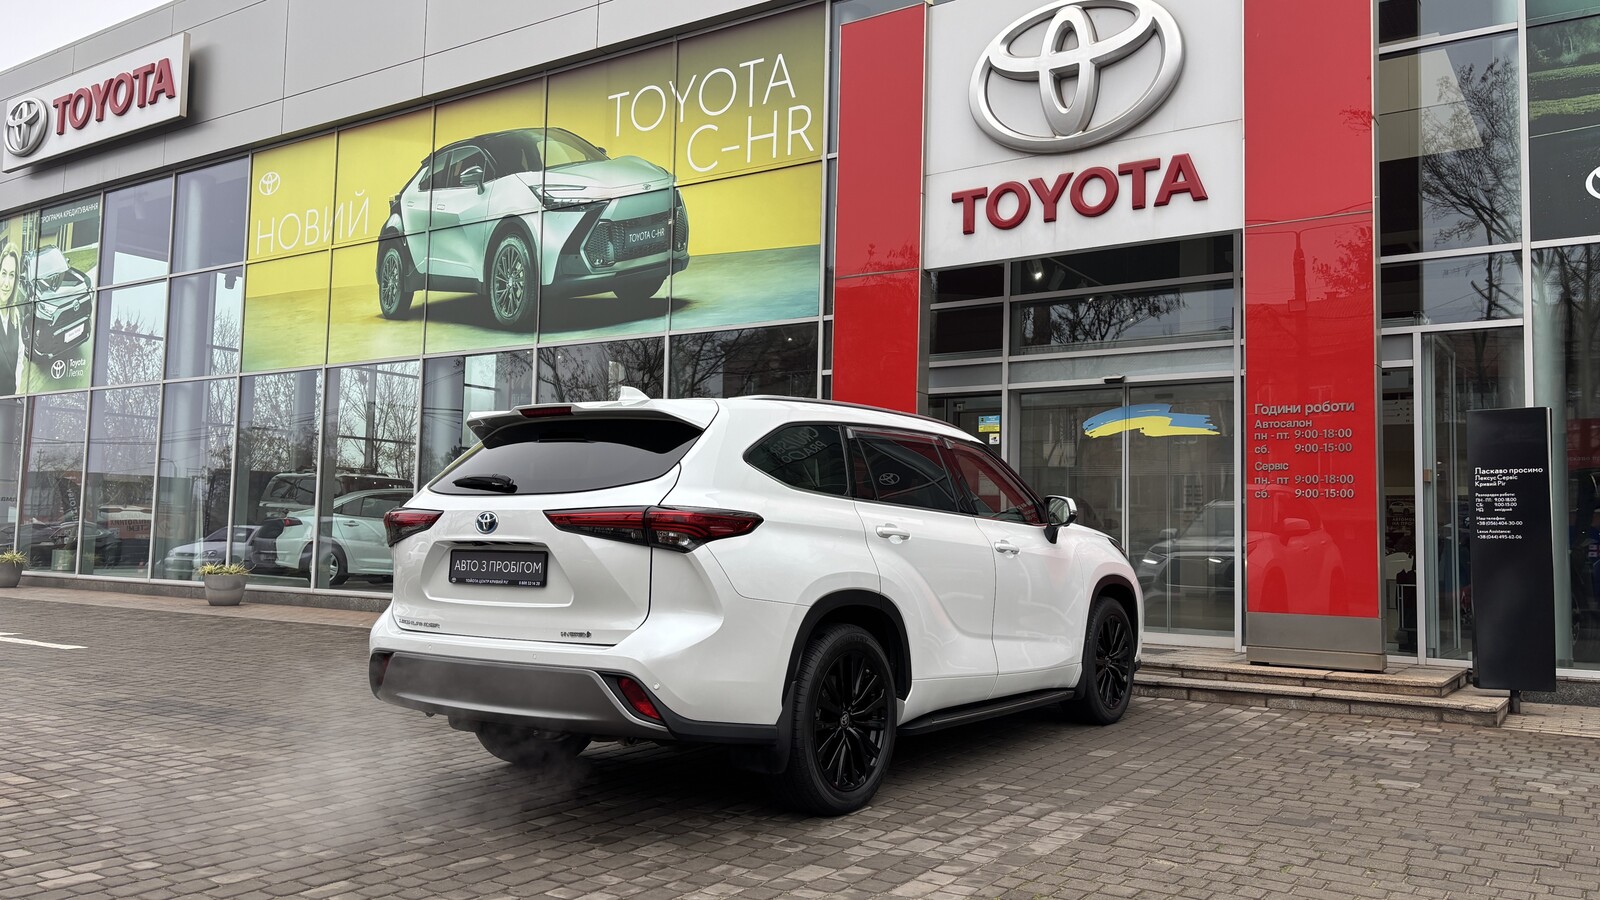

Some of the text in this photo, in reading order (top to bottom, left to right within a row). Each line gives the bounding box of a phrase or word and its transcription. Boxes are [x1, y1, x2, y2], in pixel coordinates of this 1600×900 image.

[53, 57, 176, 135] TOYOTA
[607, 52, 796, 137] TOYOTA
[686, 104, 815, 173] C-HR
[951, 152, 1209, 236] TOYOTA
[256, 189, 369, 255] НОВИЙ
[629, 228, 665, 243] TOYOTA C-HR
[69, 358, 86, 369] Toyota
[1254, 401, 1355, 415] Години роботи
[1254, 419, 1313, 429] Автосалон
[1254, 432, 1268, 440] пн
[1294, 428, 1353, 438] 9:00-18:00
[1254, 443, 1353, 454] сб. 9:00-15:00
[1254, 461, 1289, 472] Сервіс
[1475, 467, 1543, 475] Ласкаво просимо
[1294, 474, 1354, 484] 9:00-18:00
[1254, 488, 1354, 498] сб. 9:00-15:00
[454, 559, 542, 574] АВТО З ПРОБІГОМ
